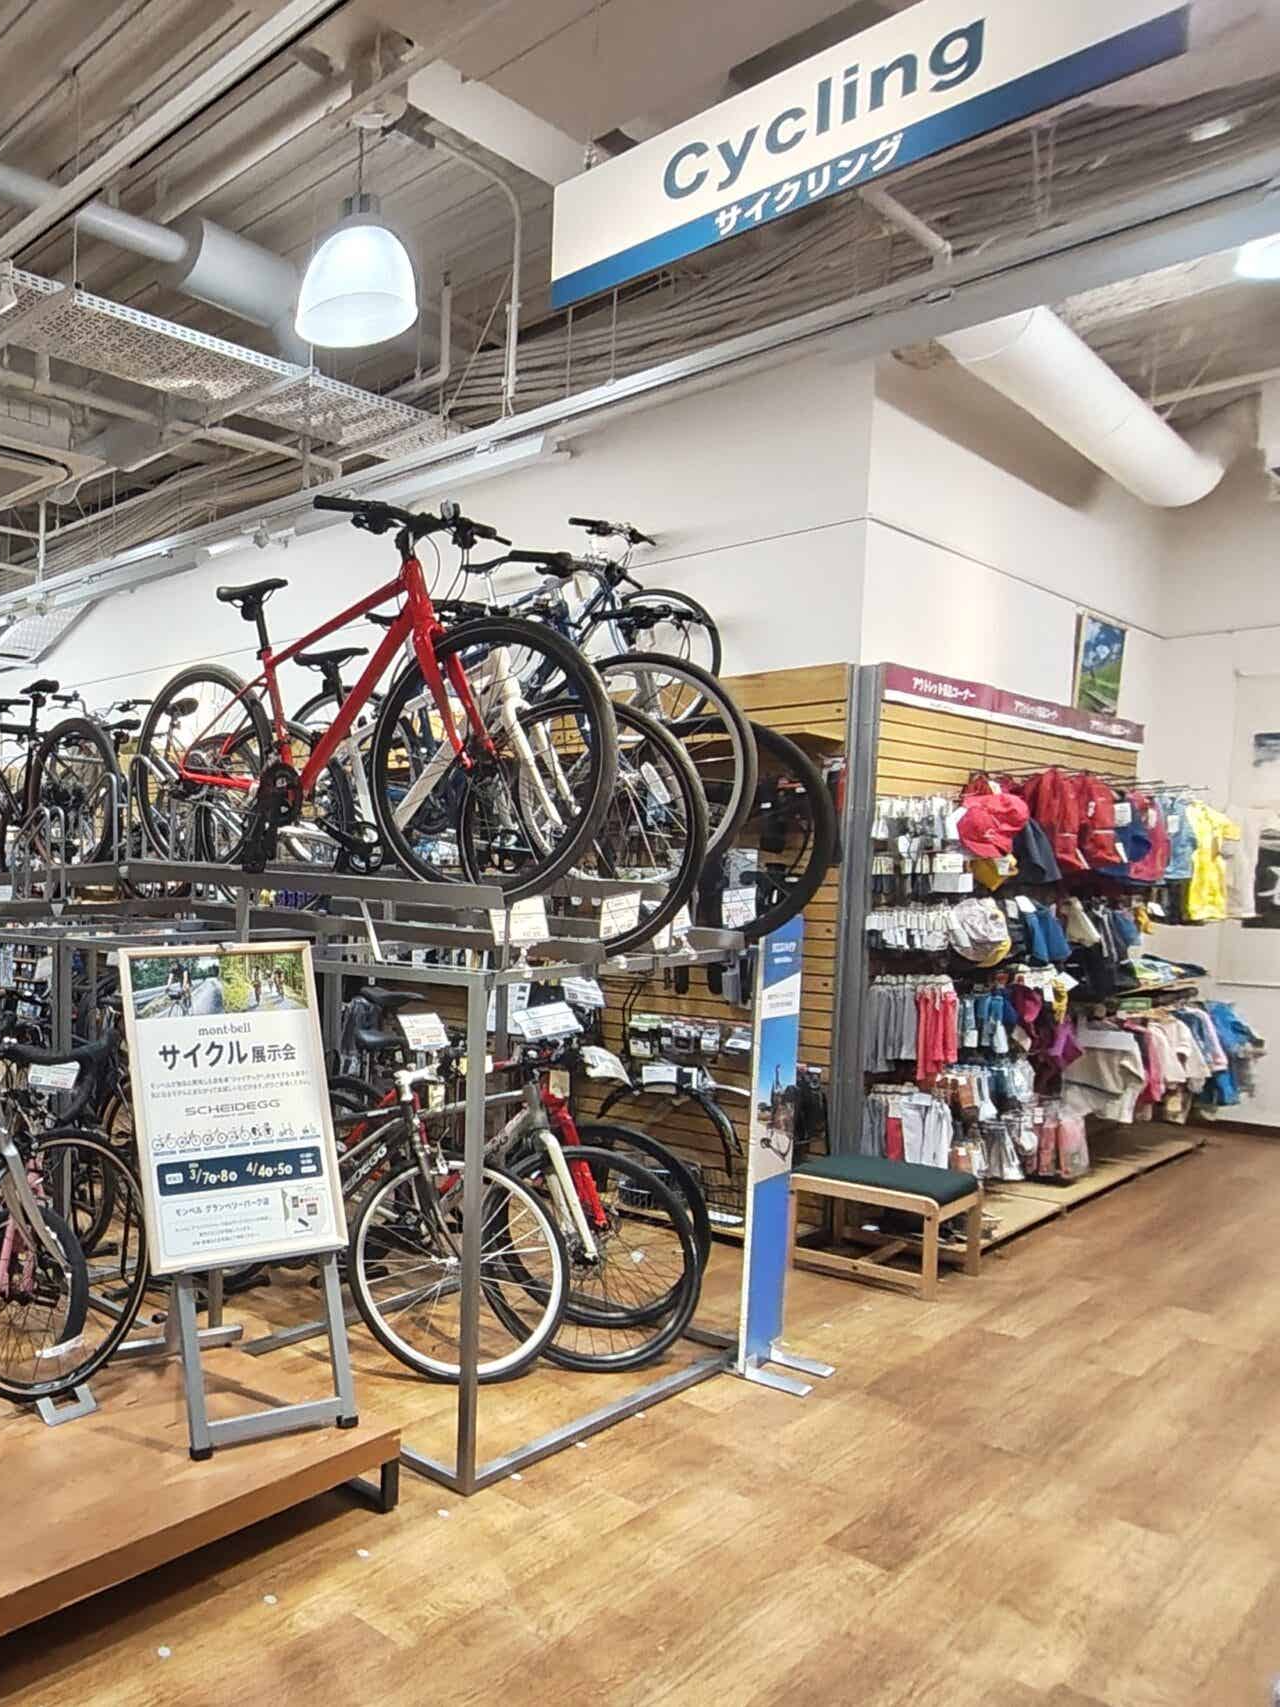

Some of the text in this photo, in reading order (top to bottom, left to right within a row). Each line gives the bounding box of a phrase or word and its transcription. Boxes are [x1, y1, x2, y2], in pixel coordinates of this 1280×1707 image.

[664, 18, 986, 200] Cycling
[714, 134, 904, 238] サイクリング
[158, 1040, 297, 1070] サイクル 展示会
[184, 1099, 281, 1117] SCHEIDEGG
